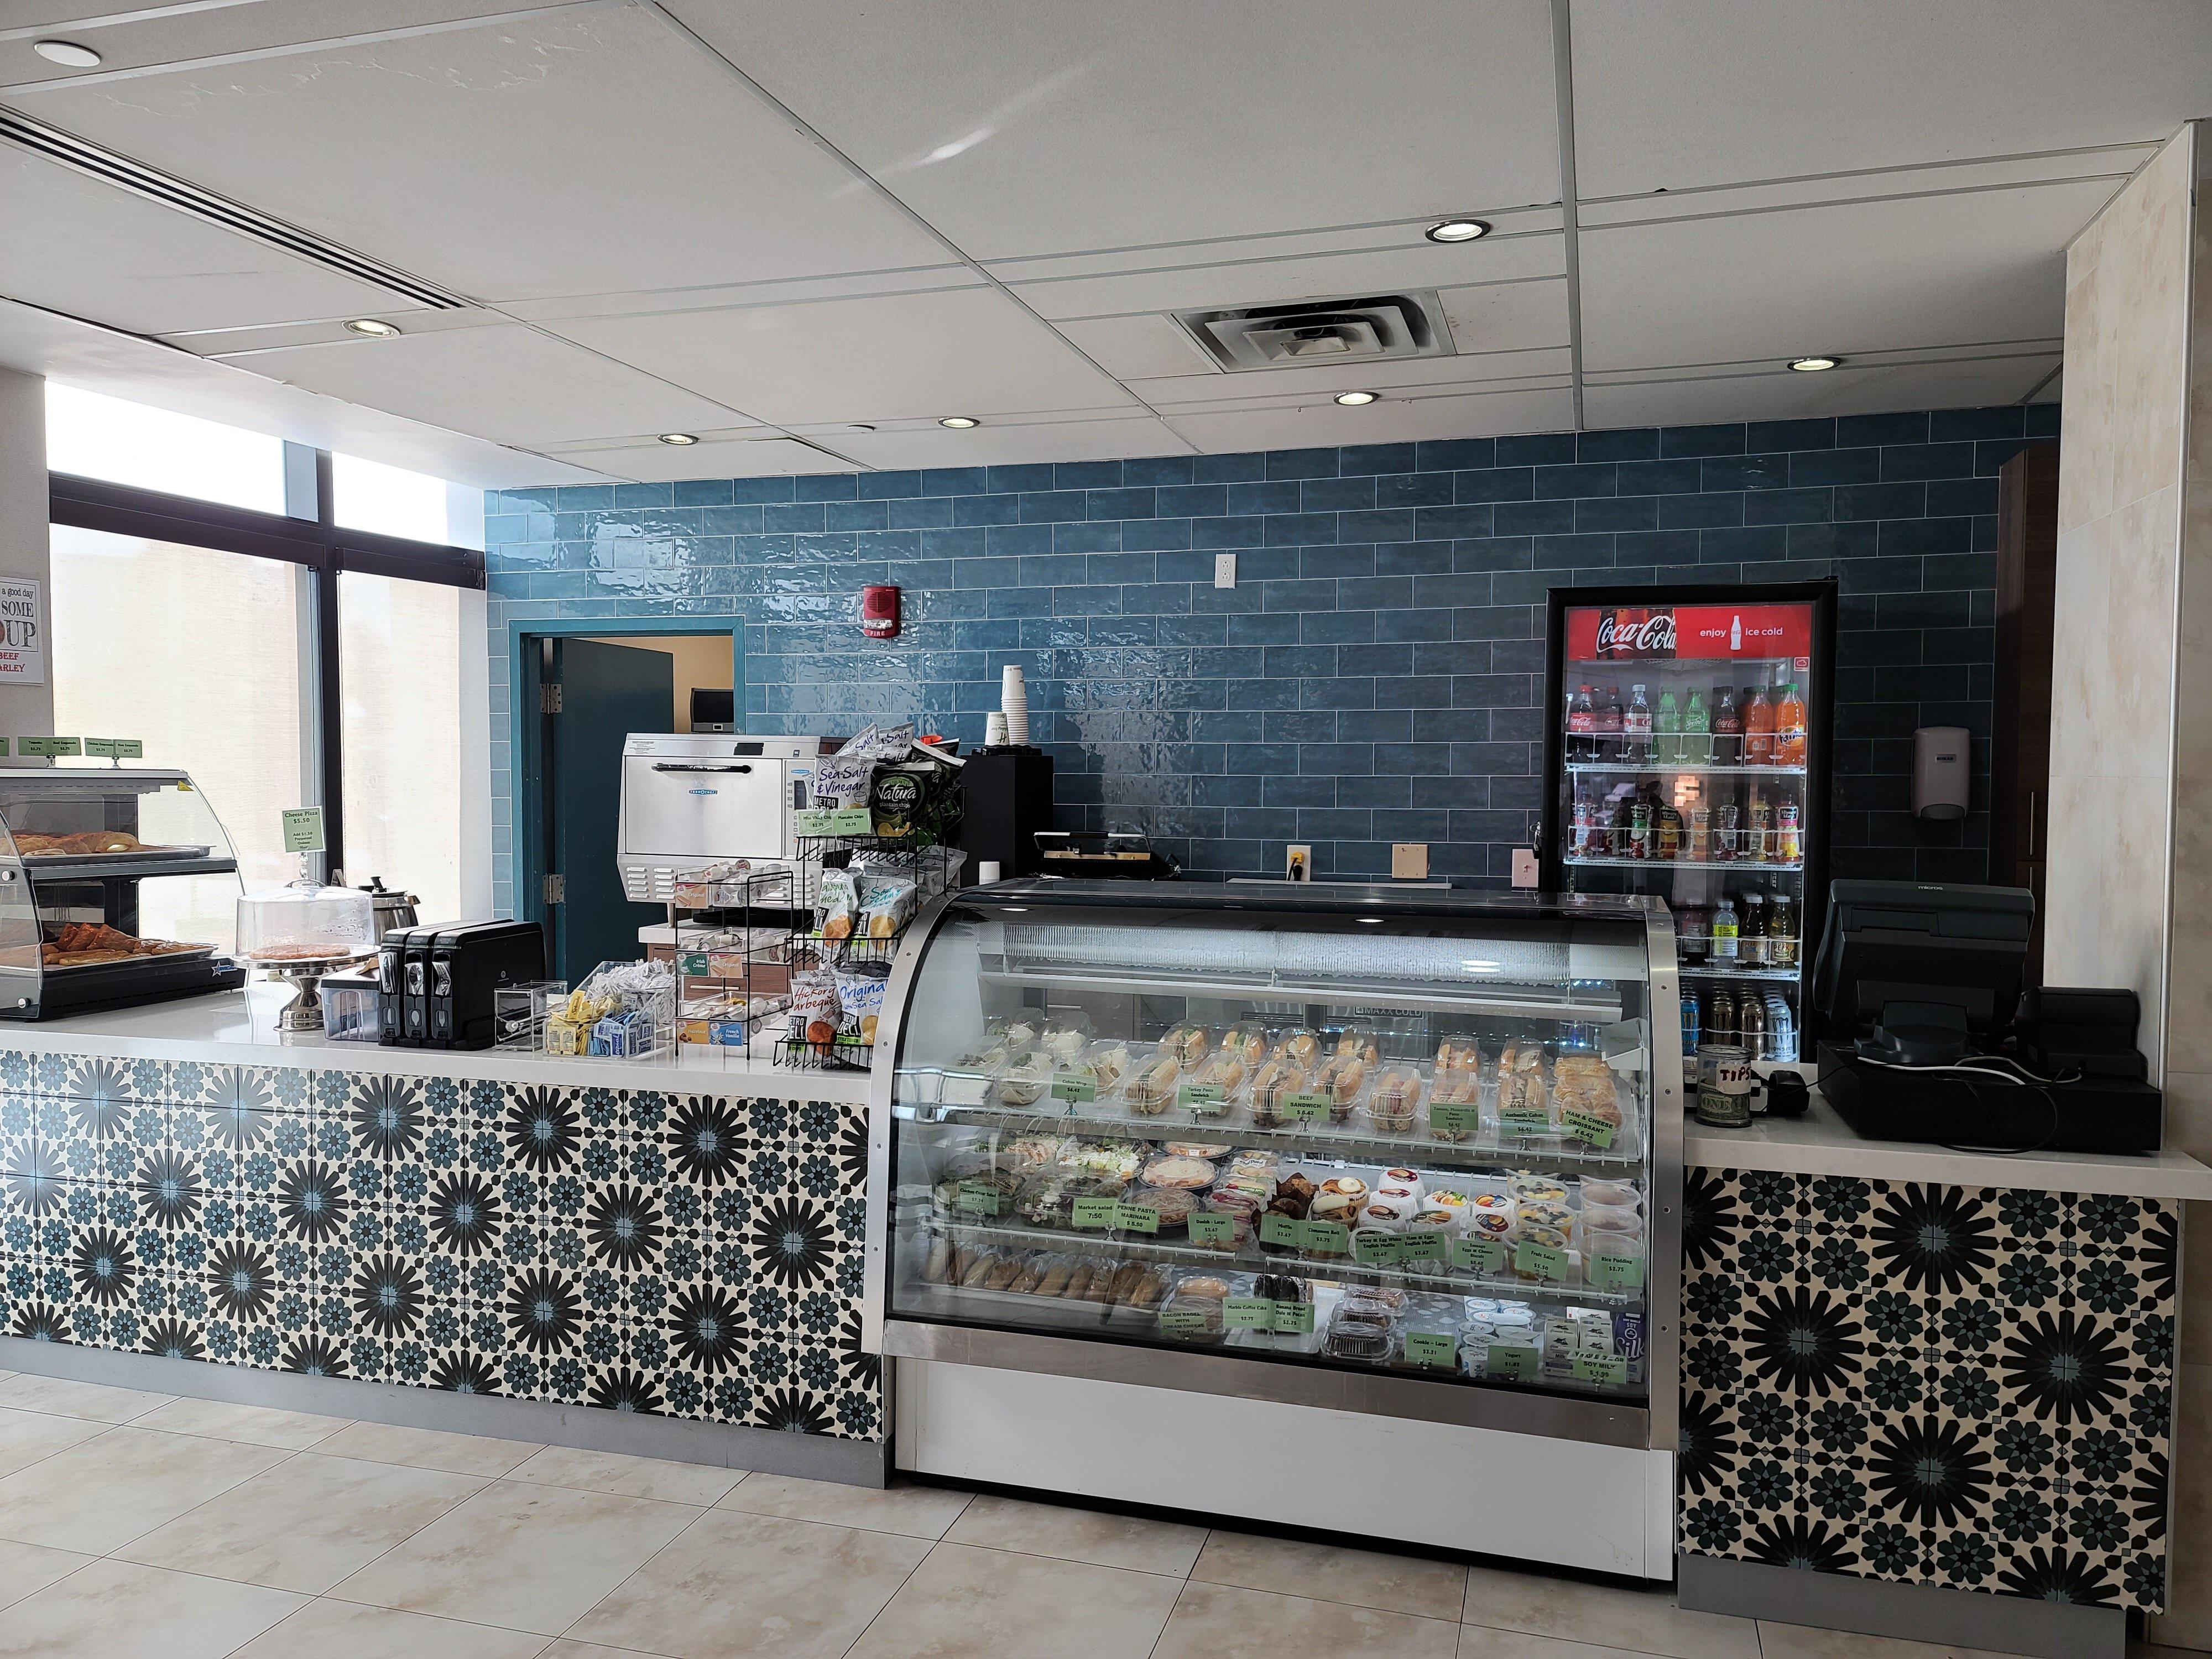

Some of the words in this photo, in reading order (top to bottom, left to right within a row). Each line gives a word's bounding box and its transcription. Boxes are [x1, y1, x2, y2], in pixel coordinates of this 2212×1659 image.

[7, 588, 22, 597] good
[23, 588, 34, 599] day
[1, 600, 34, 617] SOME
[0, 619, 36, 648] UP
[1596, 615, 1676, 653] Coca-Cola
[1700, 629, 1726, 638] enjoy
[1762, 627, 1783, 635] cold
[855, 733, 874, 750] Salt
[886, 730, 909, 743] Salt
[819, 768, 840, 781] Sea
[842, 766, 869, 779] Salt
[817, 782, 823, 795] &
[825, 780, 865, 797] Vinegar
[877, 783, 917, 802] Natura
[814, 797, 836, 807] METRO
[795, 986, 836, 1000] Hickory
[794, 998, 837, 1011] arbeque
[852, 1001, 867, 1010] Sea
[869, 996, 883, 1006] Sal
[789, 1018, 804, 1026] ETRO
[1720, 1066, 1750, 1082] TIPS
[1566, 1110, 1580, 1119] HAM
[1588, 1117, 1614, 1129] CHEESE
[1568, 1119, 1605, 1134] CROISSANT
[1580, 1131, 1594, 1139] 6.42
[1121, 1213, 1150, 1221] MARINARA
[1616, 1337, 1646, 1358] Silk
